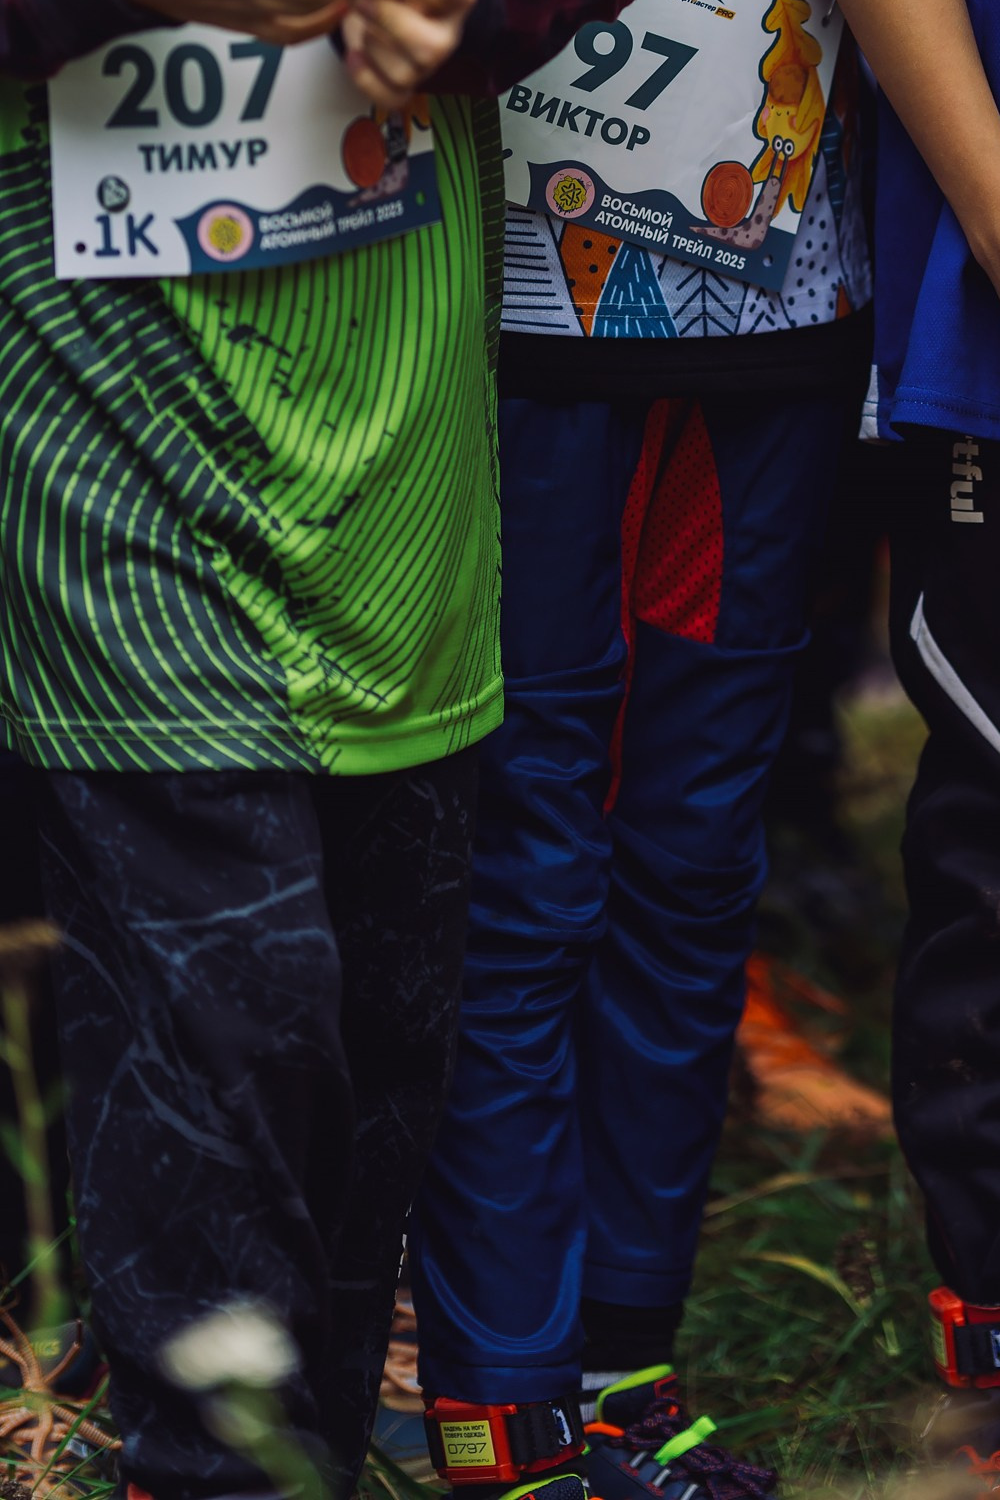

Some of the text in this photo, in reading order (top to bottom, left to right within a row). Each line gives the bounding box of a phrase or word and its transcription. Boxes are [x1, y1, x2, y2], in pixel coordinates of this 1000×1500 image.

[102, 40, 287, 129] 207
[506, 84, 651, 151] ВИКТОР
[138, 139, 269, 173] ТИМУР
[595, 210, 747, 271] АТОМНЫЙ ТРЕЙЛ 2025
[600, 194, 674, 229] ВОСЬМОЙ
[950, 435, 984, 523] tful
[447, 1442, 487, 1455] 0797
